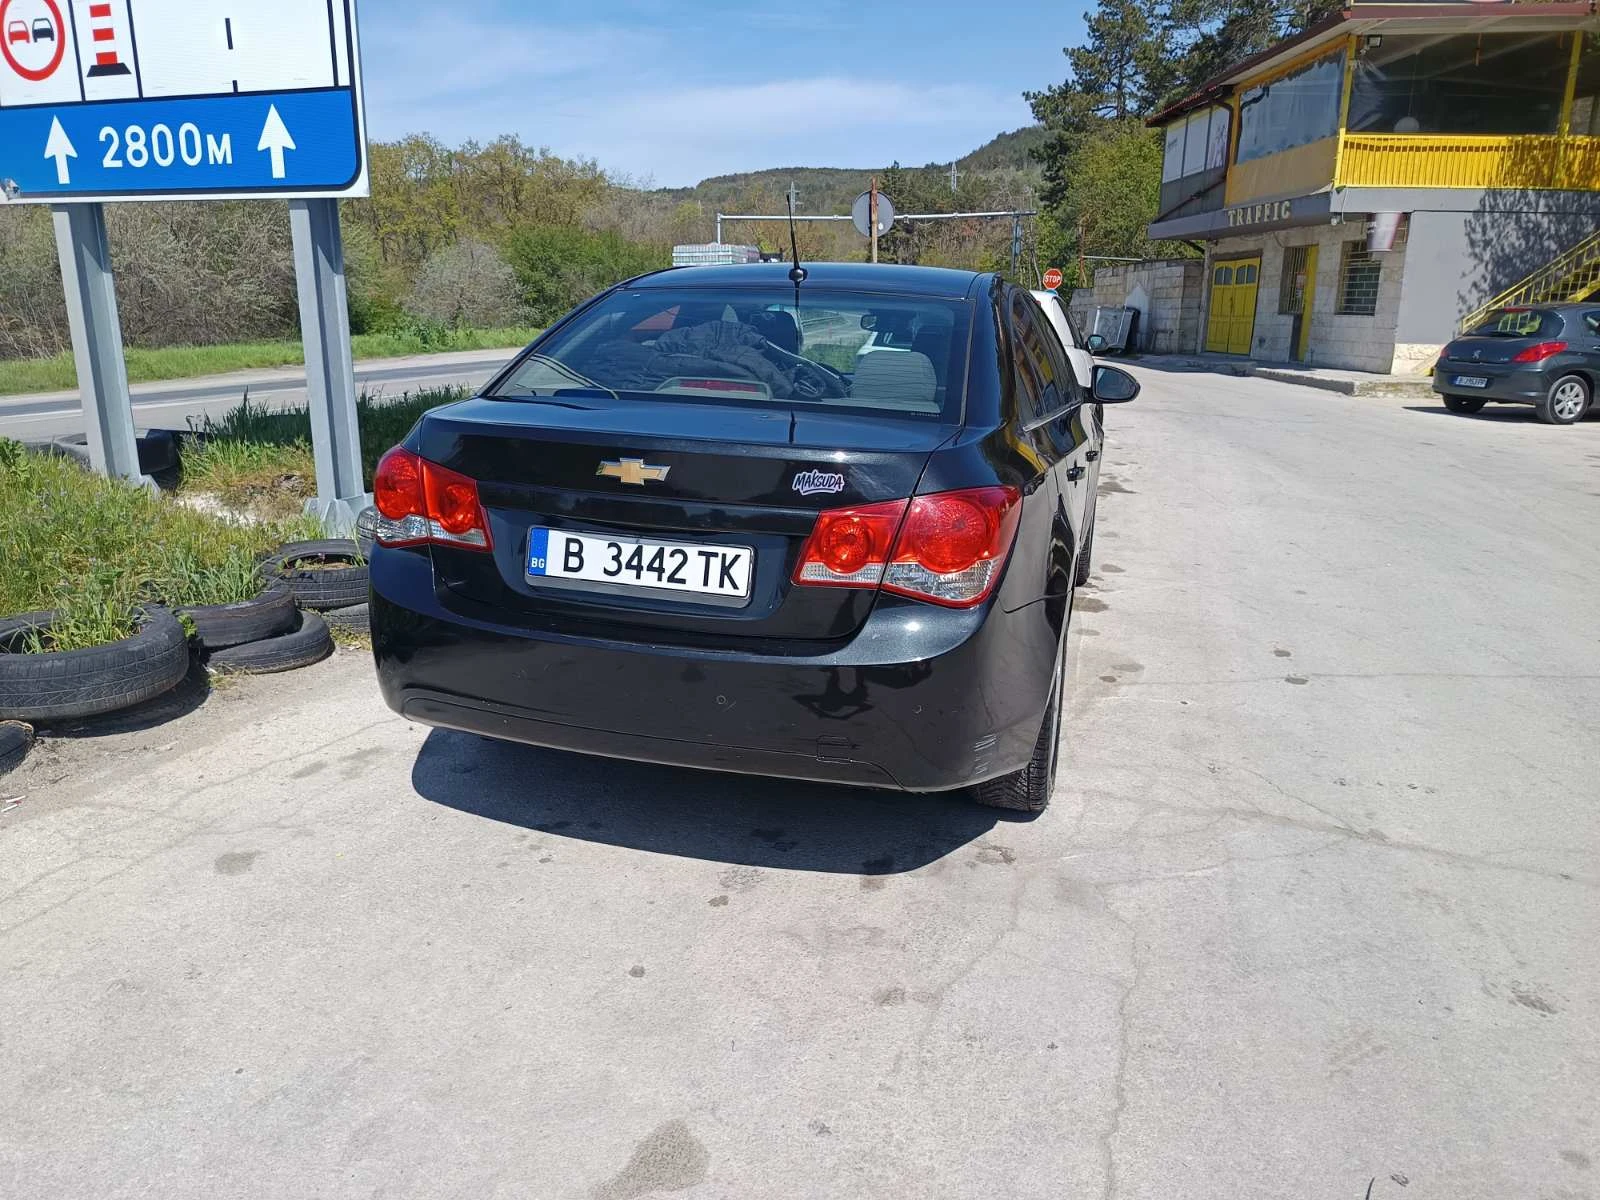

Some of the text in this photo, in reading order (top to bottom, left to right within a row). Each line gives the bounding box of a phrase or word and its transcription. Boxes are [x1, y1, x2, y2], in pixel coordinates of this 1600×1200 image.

[1227, 200, 1291, 227] TRAFFIC
[1045, 275, 1061, 283] STOP
[793, 470, 844, 491] MAKSUDA
[531, 557, 545, 569] BG
[563, 537, 741, 590] B 3442 TK
